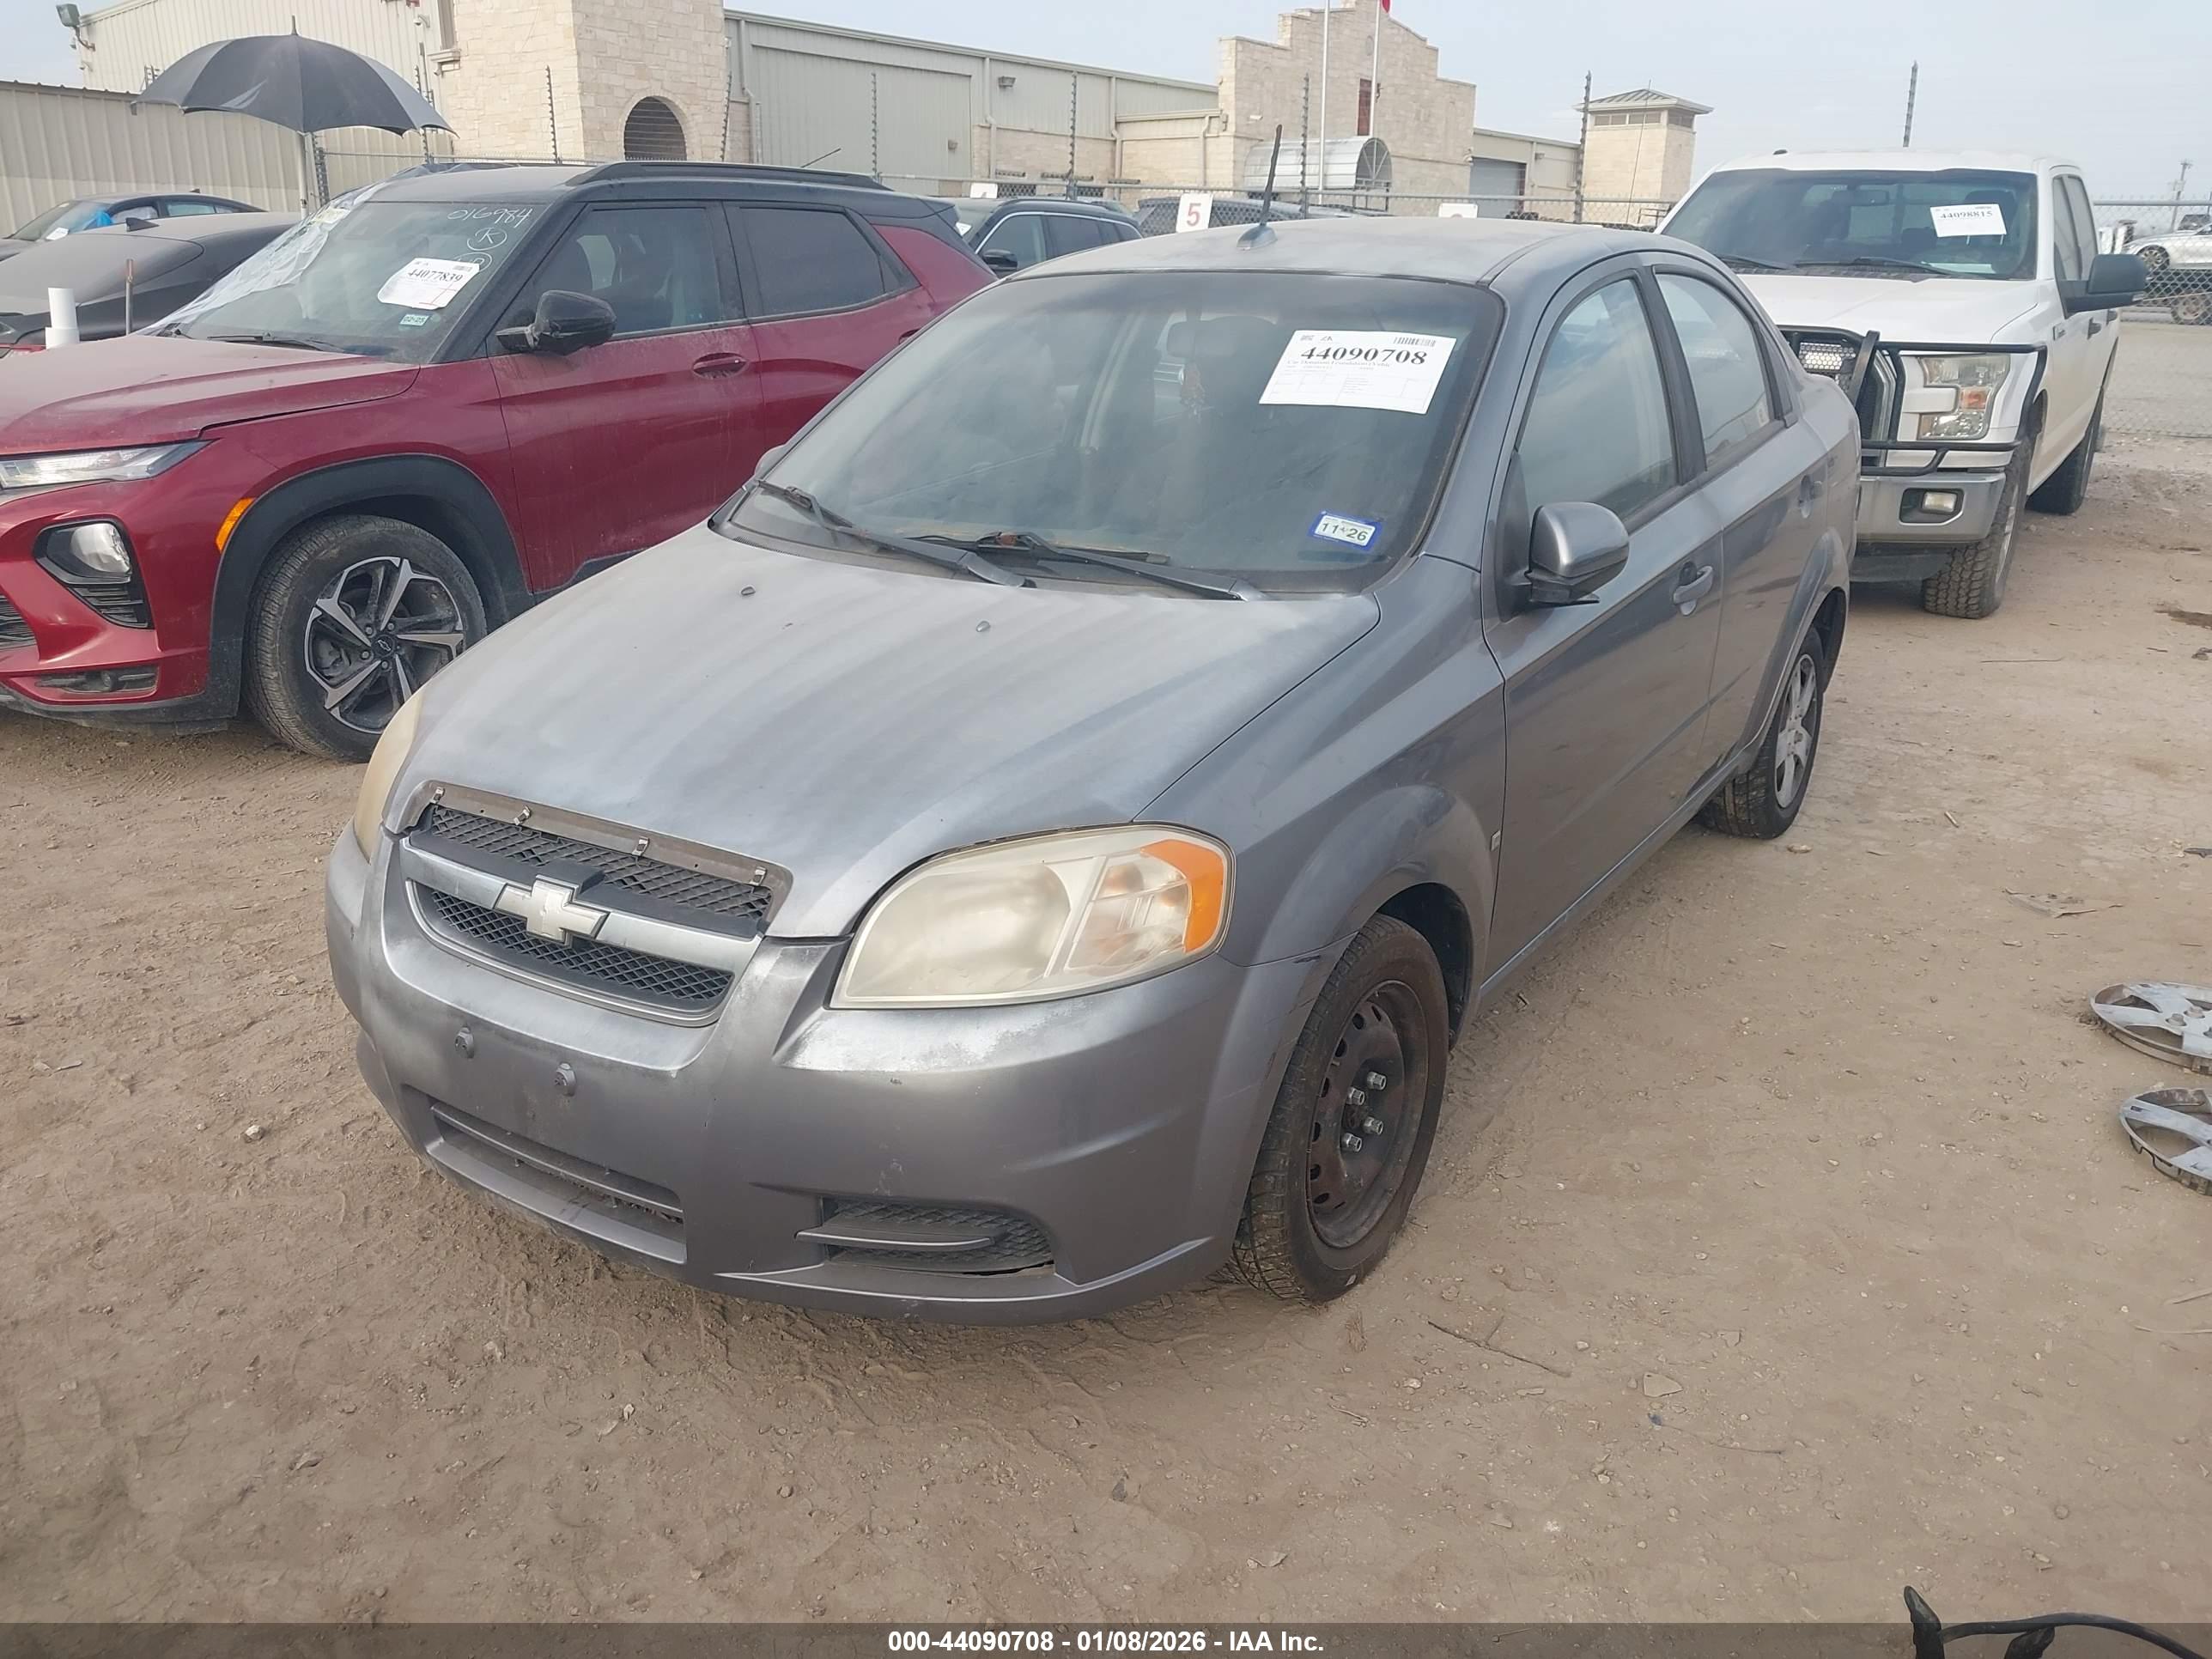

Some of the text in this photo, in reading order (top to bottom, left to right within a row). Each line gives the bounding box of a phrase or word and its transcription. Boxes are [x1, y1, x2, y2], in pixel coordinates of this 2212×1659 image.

[1186, 203, 1201, 227] 5
[408, 268, 465, 283] 44077839
[1301, 346, 1427, 365] 44090708
